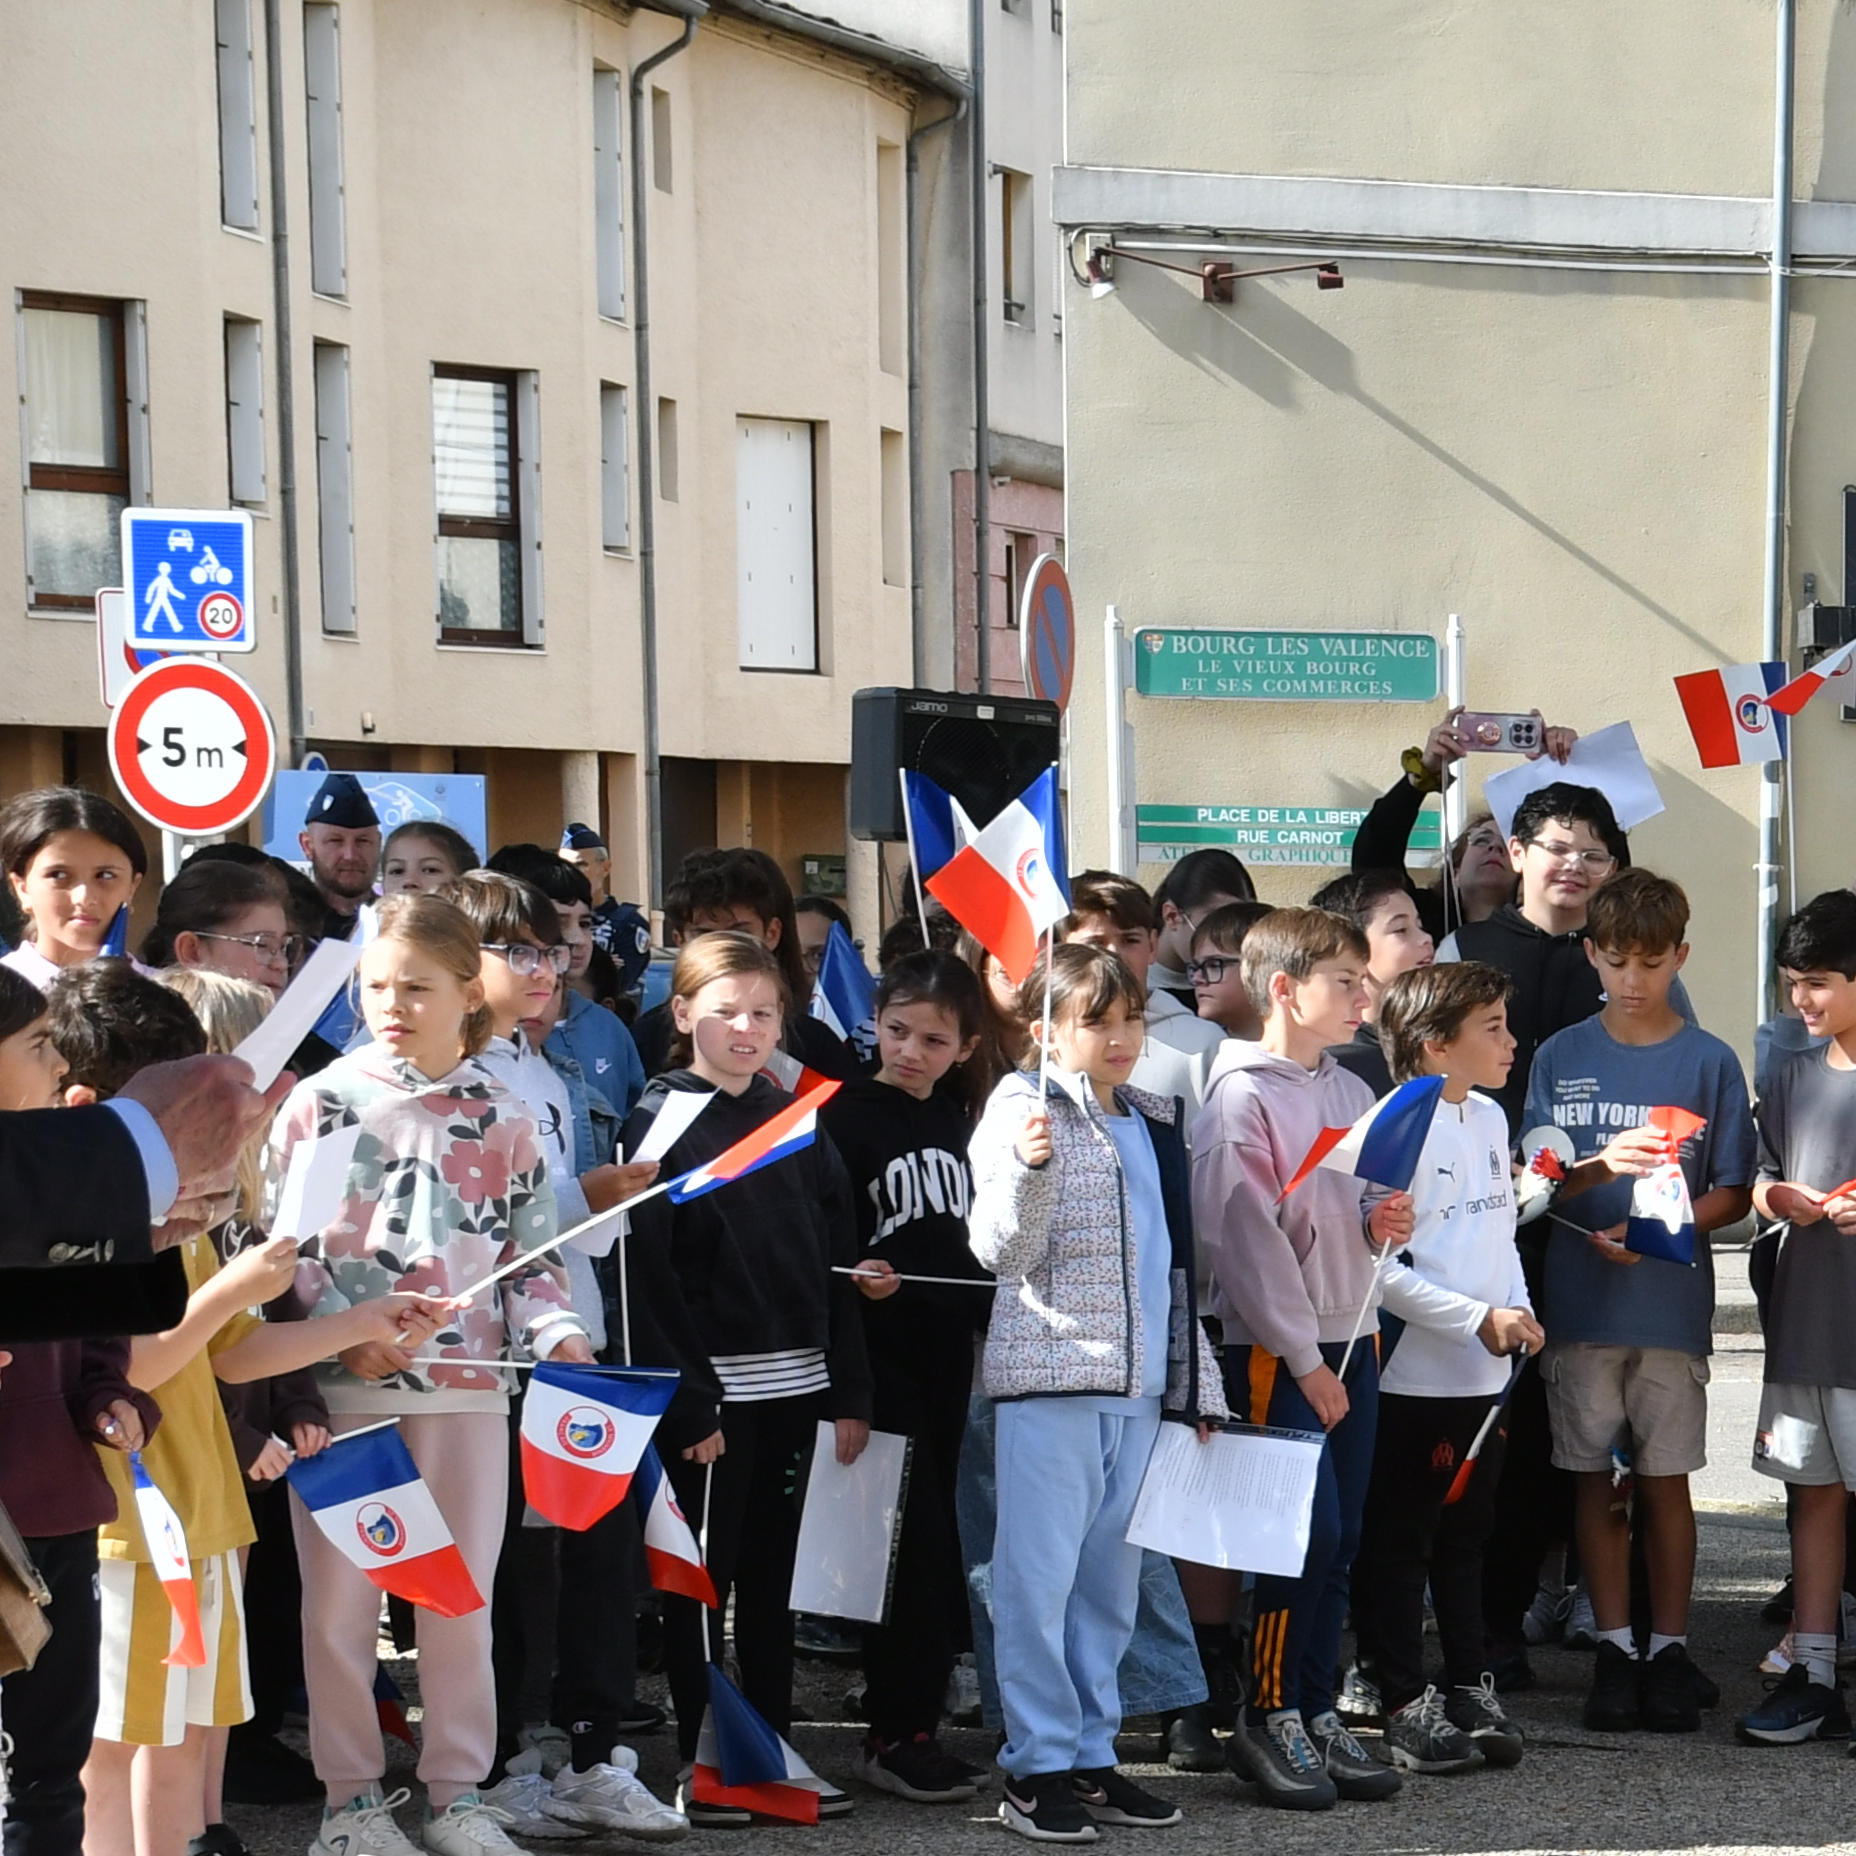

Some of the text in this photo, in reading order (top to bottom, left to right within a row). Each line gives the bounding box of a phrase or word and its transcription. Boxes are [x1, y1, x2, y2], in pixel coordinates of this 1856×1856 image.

[208, 607, 234, 625] 20
[1171, 634, 1431, 660] BOURG LES VALENCE
[1197, 659, 1378, 677] LE VIEUX BOURG
[1180, 677, 1394, 696] ET SES COMMERCES
[161, 726, 225, 769] 5 m
[1197, 808, 1368, 826] PLACE DE LA LIBER
[1236, 829, 1344, 846] RUE CARNOT
[1553, 1102, 1595, 1127] NEW
[867, 1147, 977, 1248] LONDO
